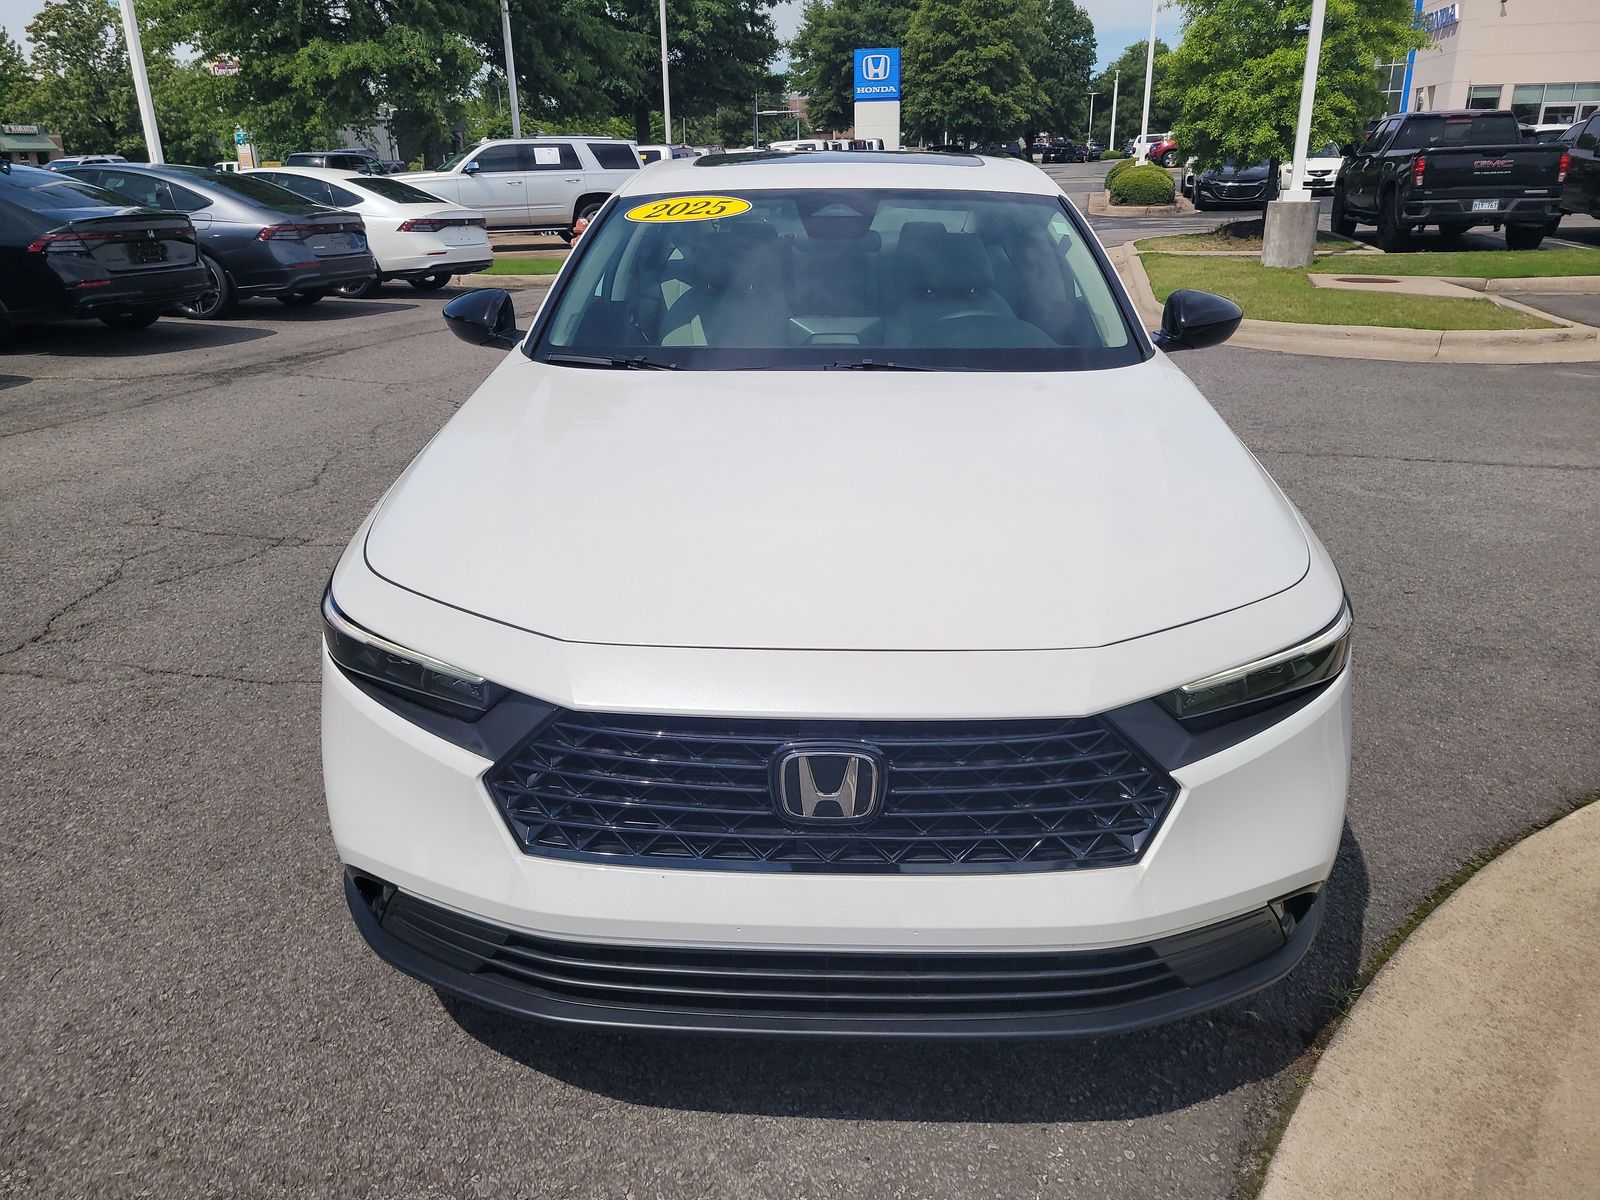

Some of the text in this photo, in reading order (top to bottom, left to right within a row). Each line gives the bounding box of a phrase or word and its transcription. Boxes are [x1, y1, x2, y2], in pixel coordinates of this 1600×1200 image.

[856, 86, 897, 94] HONDA
[1473, 160, 1514, 168] GMC
[643, 201, 733, 219] 2025
